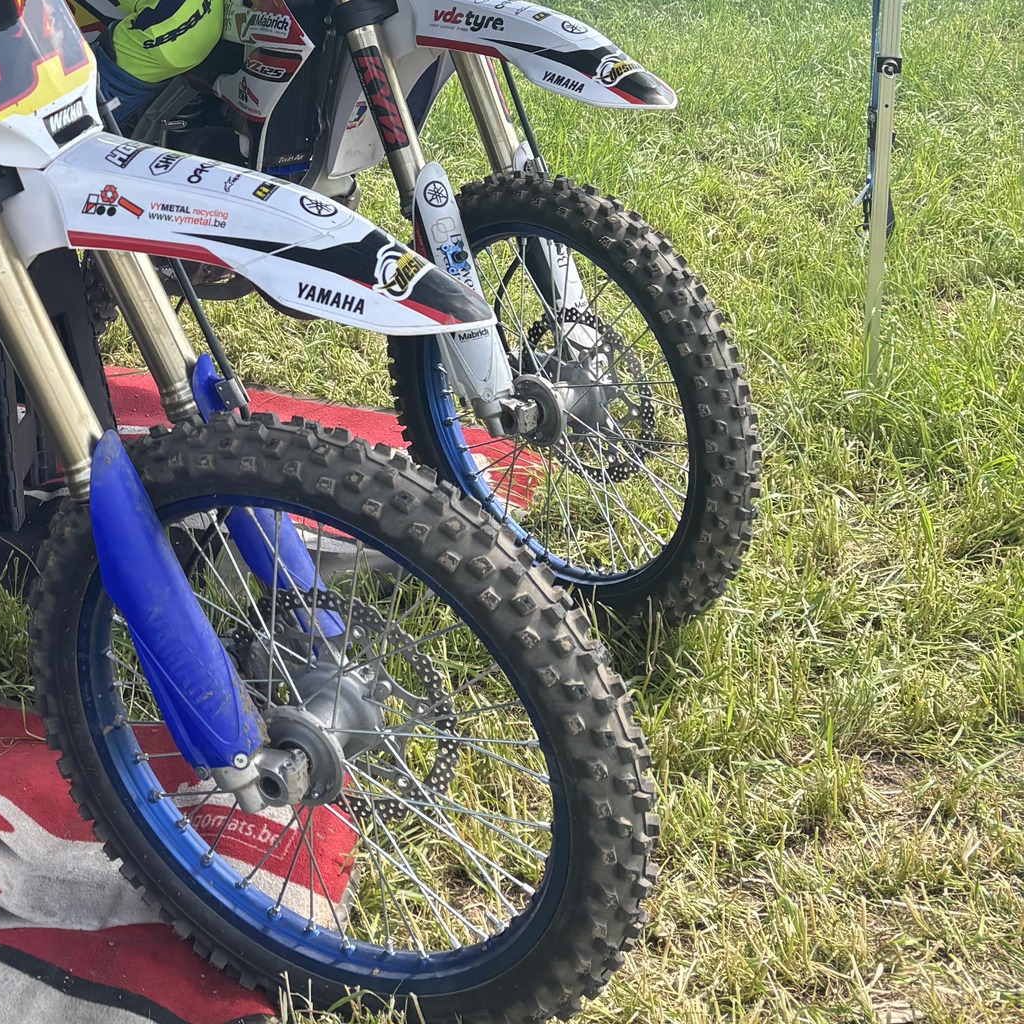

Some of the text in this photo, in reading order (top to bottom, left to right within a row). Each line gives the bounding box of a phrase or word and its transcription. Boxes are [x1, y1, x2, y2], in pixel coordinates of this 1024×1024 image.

[256, 12, 290, 31] Mabrick
[246, 57, 286, 77] YZ125
[542, 70, 586, 95] YAMAHA
[48, 100, 84, 133] WKND
[148, 212, 227, 228] www.vymetal.be
[149, 202, 229, 220] VYMETAL recycling
[297, 282, 366, 315] YAMAHA
[458, 327, 490, 342] Mabrick
